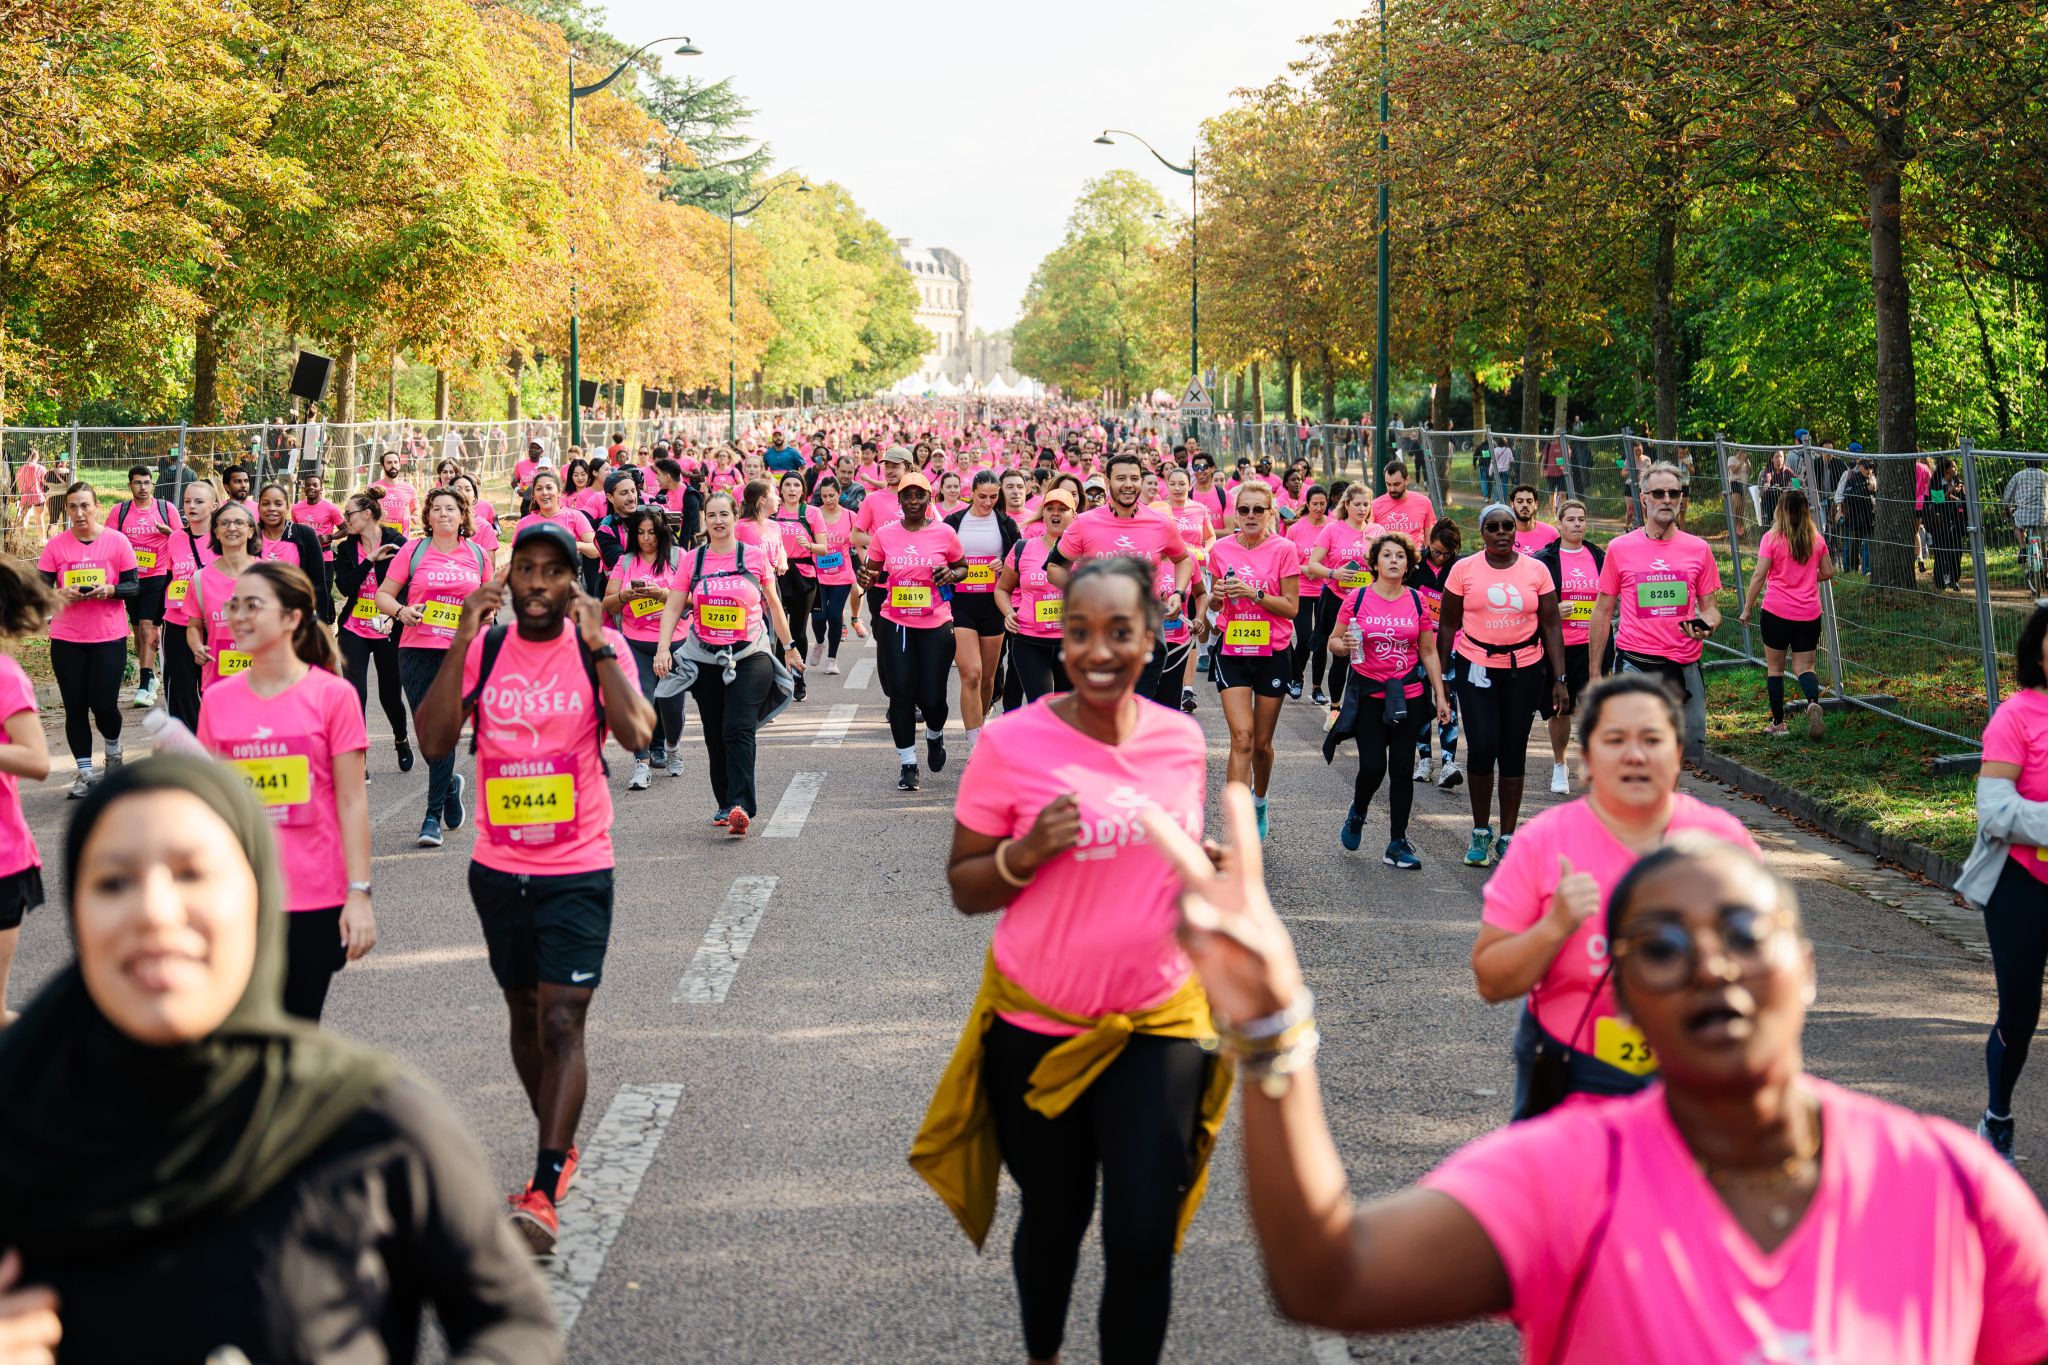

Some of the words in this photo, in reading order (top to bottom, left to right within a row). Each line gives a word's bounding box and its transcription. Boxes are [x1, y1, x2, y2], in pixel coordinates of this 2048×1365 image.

[1182, 408, 1208, 416] DANGER
[1384, 521, 1419, 531] ODYSSEA
[1096, 548, 1152, 561] ODYSSEA
[890, 554, 933, 567] ODYSSEA
[71, 562, 97, 570] ODYSSEA
[71, 575, 98, 584] 28109
[426, 569, 481, 583] ODYSSEA
[1646, 574, 1677, 582] ODYSSEA
[696, 579, 747, 591] ODYSSEA
[899, 579, 923, 587] ODYSSEA
[898, 593, 924, 601] 28819
[1650, 589, 1676, 599] 8285
[436, 594, 465, 606] ODYSSEA
[708, 598, 738, 606] ODYSSEA
[708, 612, 738, 622] 27810
[1235, 611, 1262, 621] ODYSSEA
[1366, 615, 1415, 627] ODYSSEA
[1485, 614, 1528, 630] ODYSSEA
[1232, 628, 1262, 638] 21243
[482, 685, 584, 714] ODYSSEA
[232, 743, 289, 760] ODYSSEA
[499, 760, 556, 777] ODYSSEA
[501, 792, 558, 810] 29444
